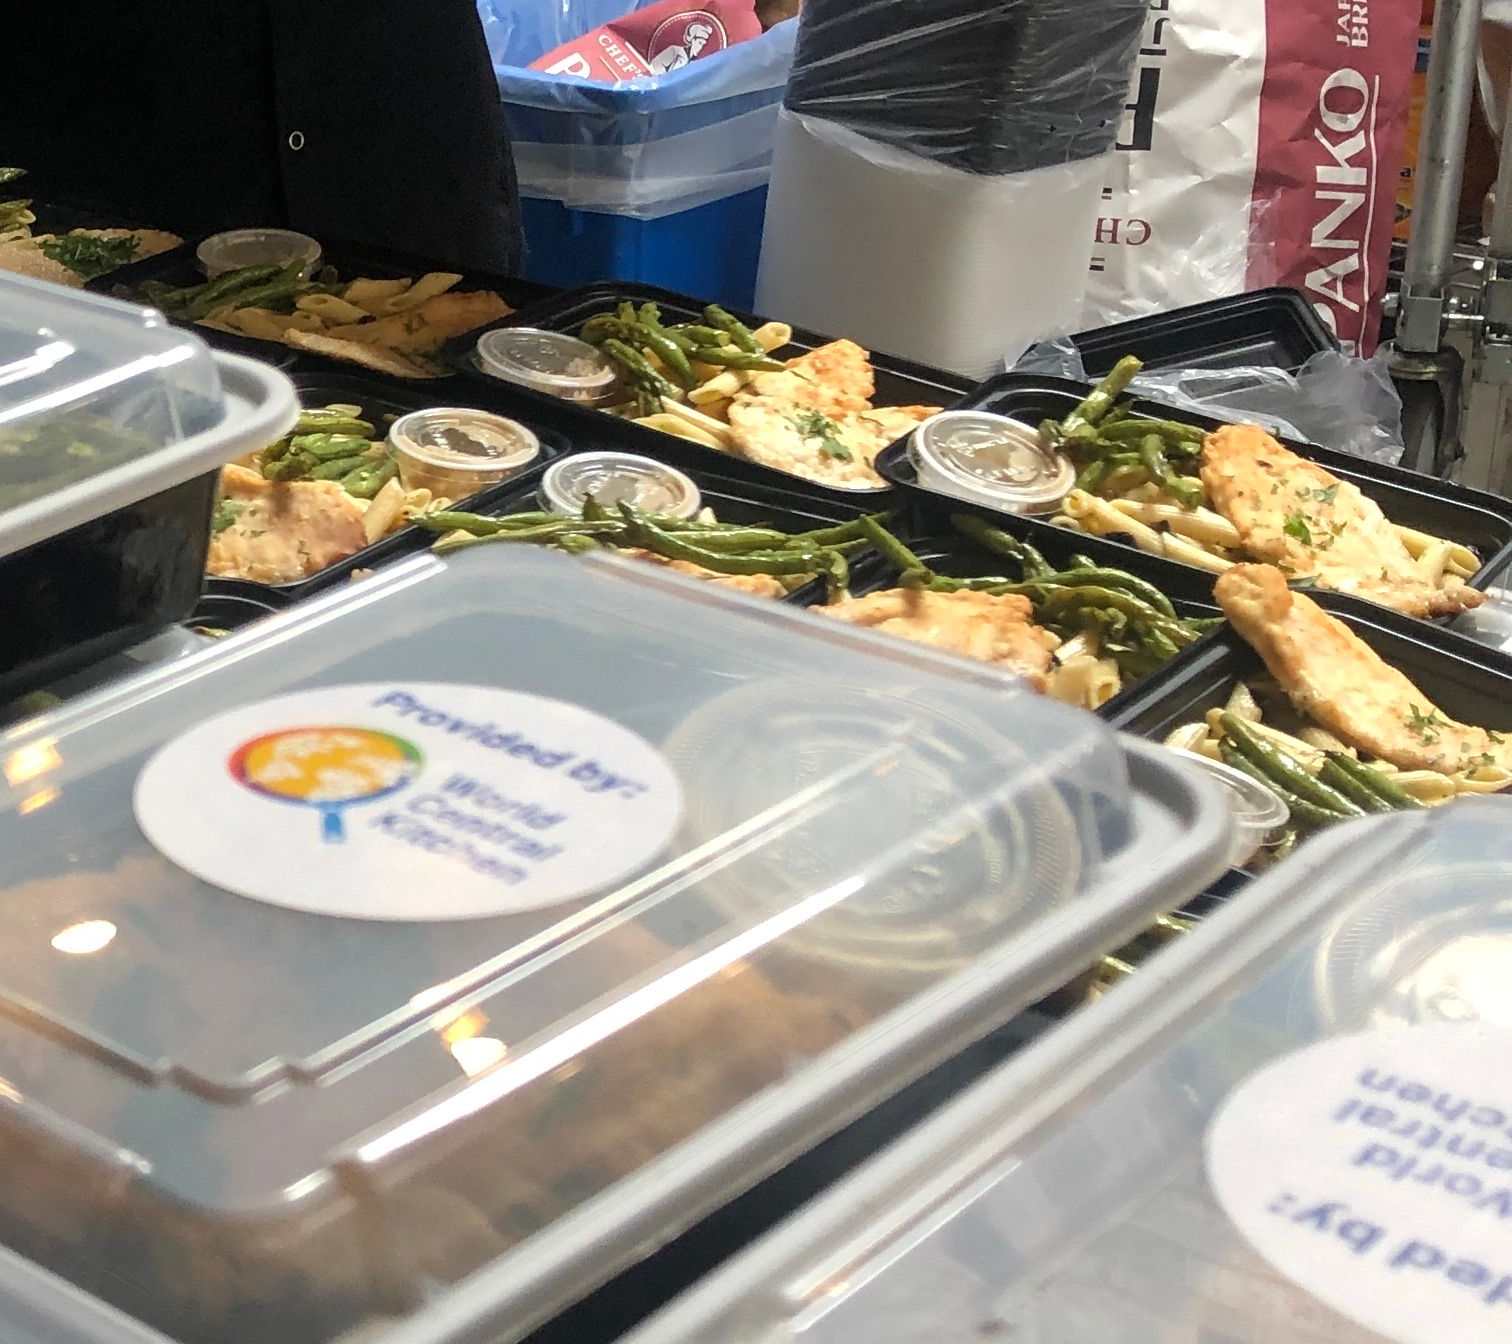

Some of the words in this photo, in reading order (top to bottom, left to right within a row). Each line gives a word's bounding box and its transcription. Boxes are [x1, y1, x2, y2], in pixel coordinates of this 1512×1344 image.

[372, 690, 574, 769] Provided
[566, 756, 649, 799] by:
[406, 793, 563, 862] Central
[440, 773, 568, 831] World
[369, 810, 529, 885] Kitchen
[1333, 1098, 1512, 1169] entral
